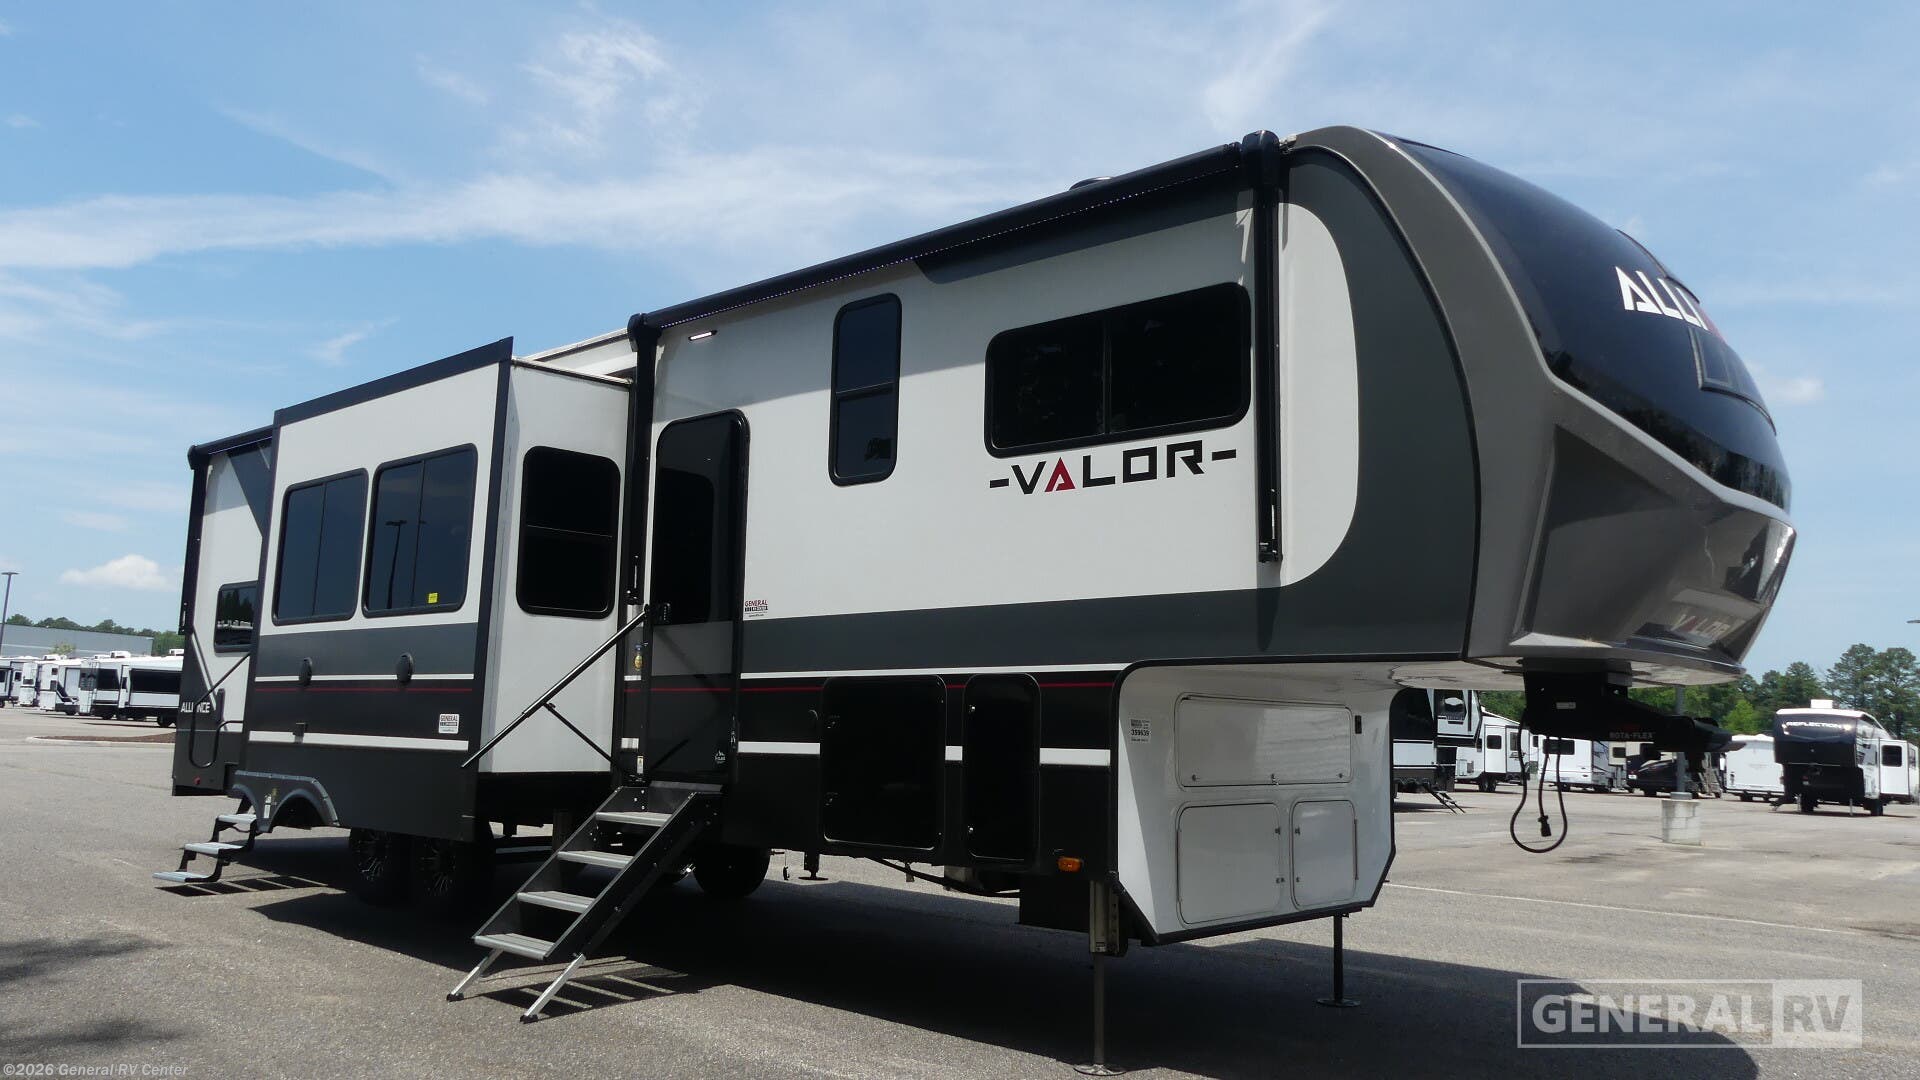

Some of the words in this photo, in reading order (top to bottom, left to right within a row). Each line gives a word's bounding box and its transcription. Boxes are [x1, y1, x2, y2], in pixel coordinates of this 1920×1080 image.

[1615, 266, 1727, 341] ALLI
[181, 701, 210, 713] ALLINCE
[1786, 721, 1842, 729] REFLECTION
